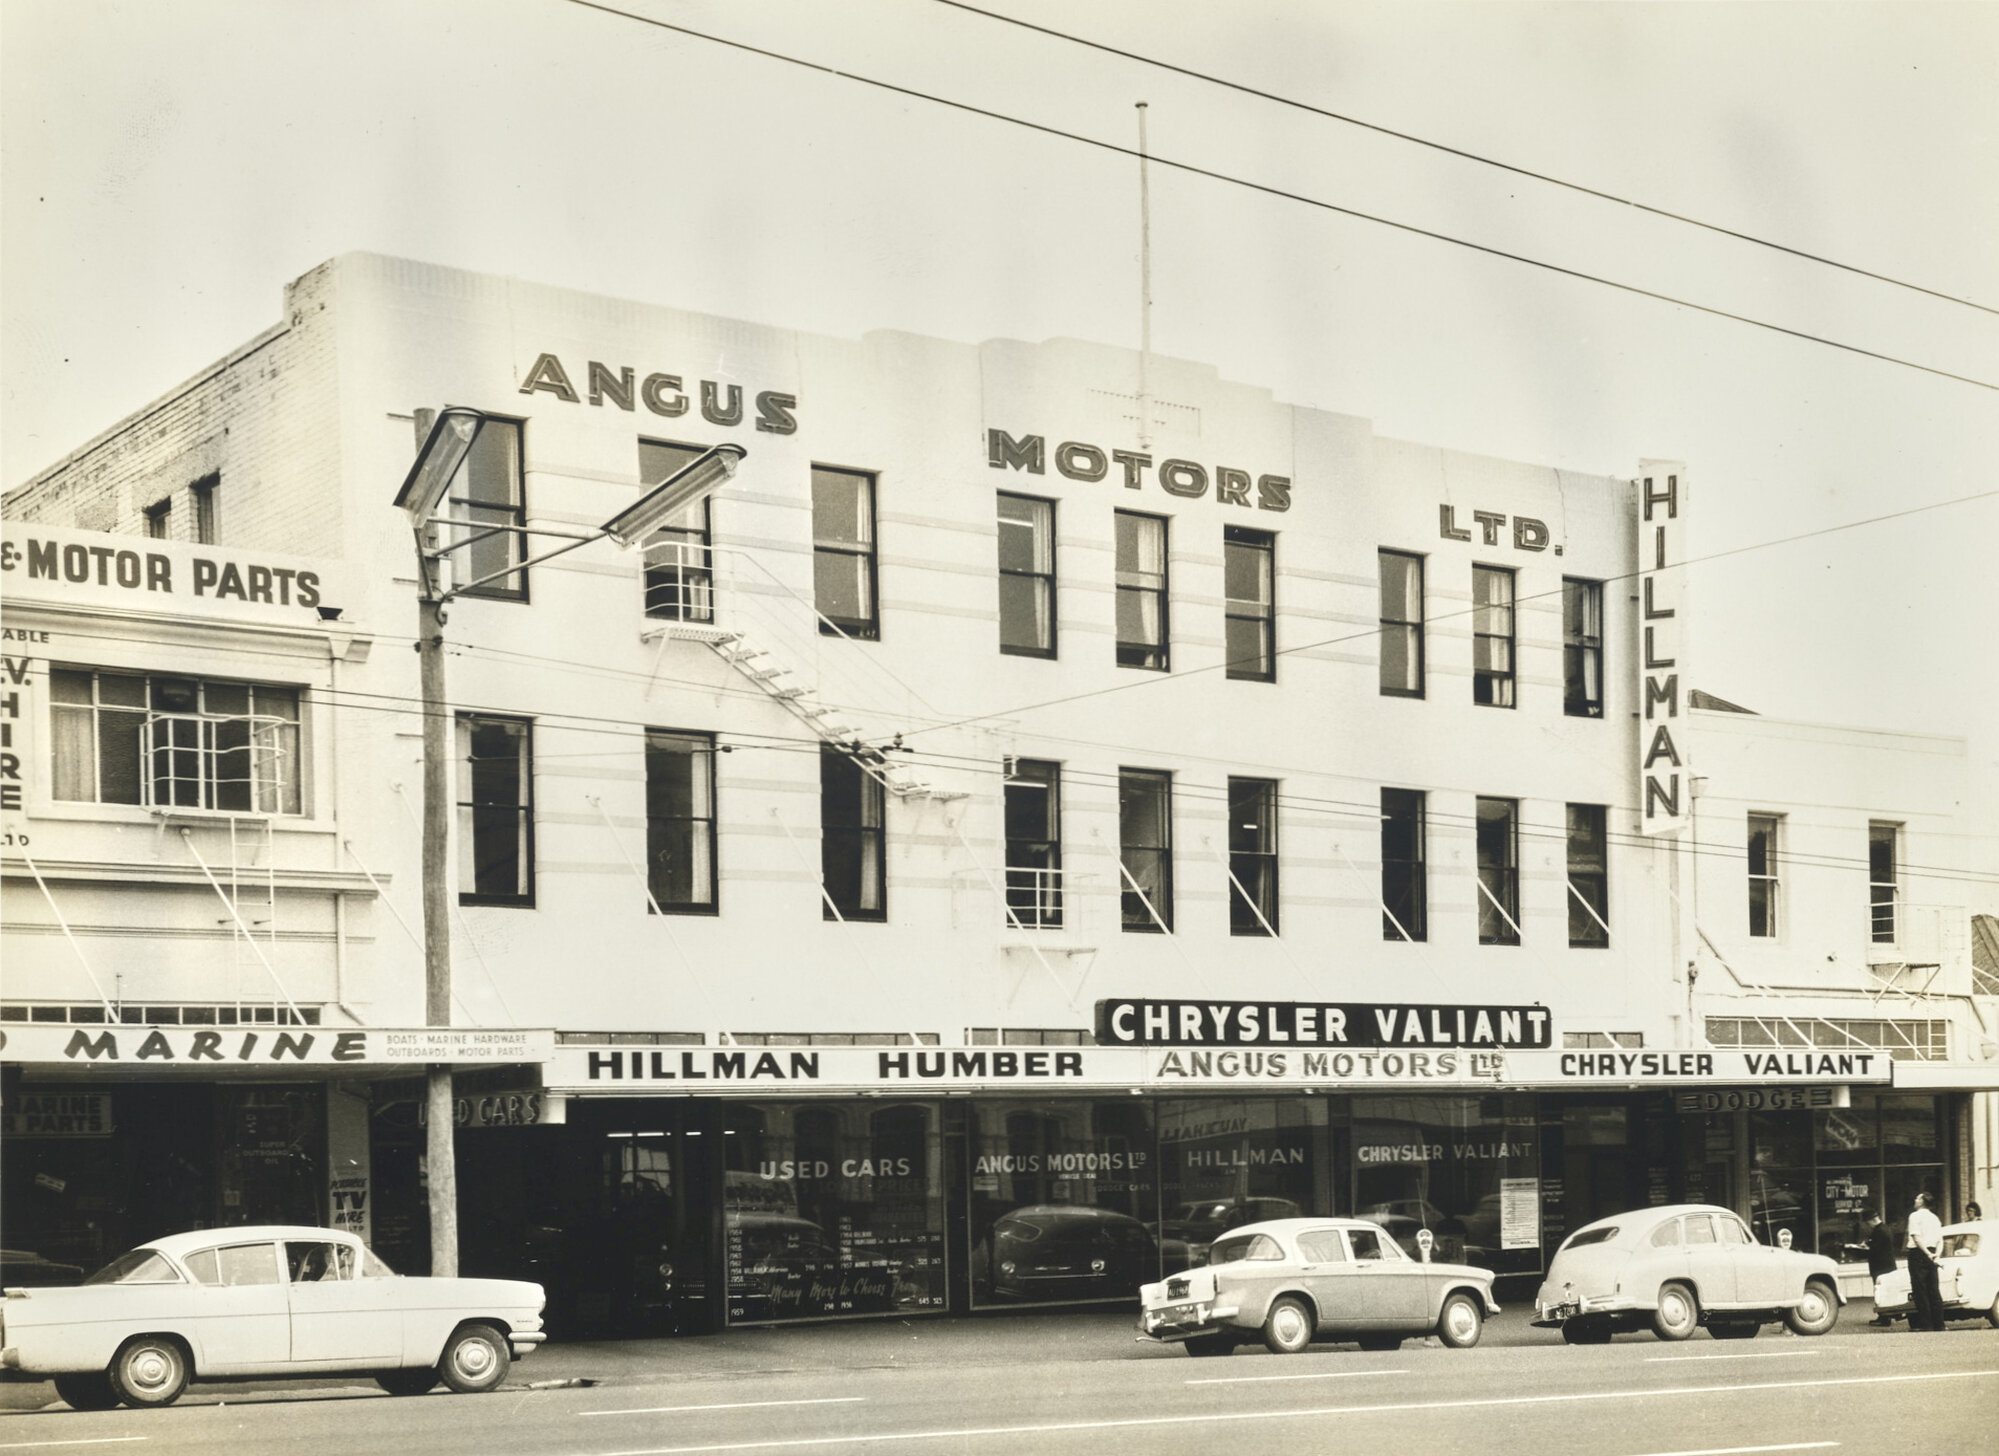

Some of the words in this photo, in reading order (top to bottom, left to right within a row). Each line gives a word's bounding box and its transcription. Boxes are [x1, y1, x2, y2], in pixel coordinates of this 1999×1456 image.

[518, 352, 798, 436] ANGUS
[988, 428, 1291, 513] MOTORS
[1439, 503, 1563, 556] LTD.
[28, 538, 173, 593] MOTOR
[192, 558, 321, 608] PARTS
[1643, 475, 1682, 818] HILLMAN
[1111, 1004, 1348, 1042] CHRYSLER
[1374, 1008, 1547, 1044] VALIANT
[64, 1029, 367, 1061] MARINE
[386, 1034, 418, 1045] BOATS
[427, 1034, 467, 1045] MARINE
[473, 1034, 527, 1045] HARDWARE
[386, 1047, 447, 1057] OUTBOARDS
[457, 1046, 492, 1057] MOTOR
[497, 1046, 525, 1057] PARTS
[588, 1052, 819, 1079] HILLMAN
[878, 1052, 1083, 1078] HUMBER
[1156, 1051, 1287, 1078] ANGUS
[1303, 1052, 1457, 1078] MOTORS
[1561, 1054, 1713, 1076] CHRYSLER
[1744, 1054, 1874, 1076] VALIANT
[418, 1098, 473, 1126] UD
[478, 1094, 540, 1126] CARS
[1704, 1087, 1805, 1111] DODGE
[975, 1154, 1040, 1173] ANGUS
[1047, 1153, 1124, 1172] MOTORS
[1187, 1148, 1304, 1167] HILLMAN
[1357, 1144, 1444, 1162] CHRYSLER
[1453, 1142, 1533, 1159] VALIANT
[759, 1160, 830, 1180] USED
[841, 1158, 911, 1178] CARS
[332, 1191, 367, 1209] TV
